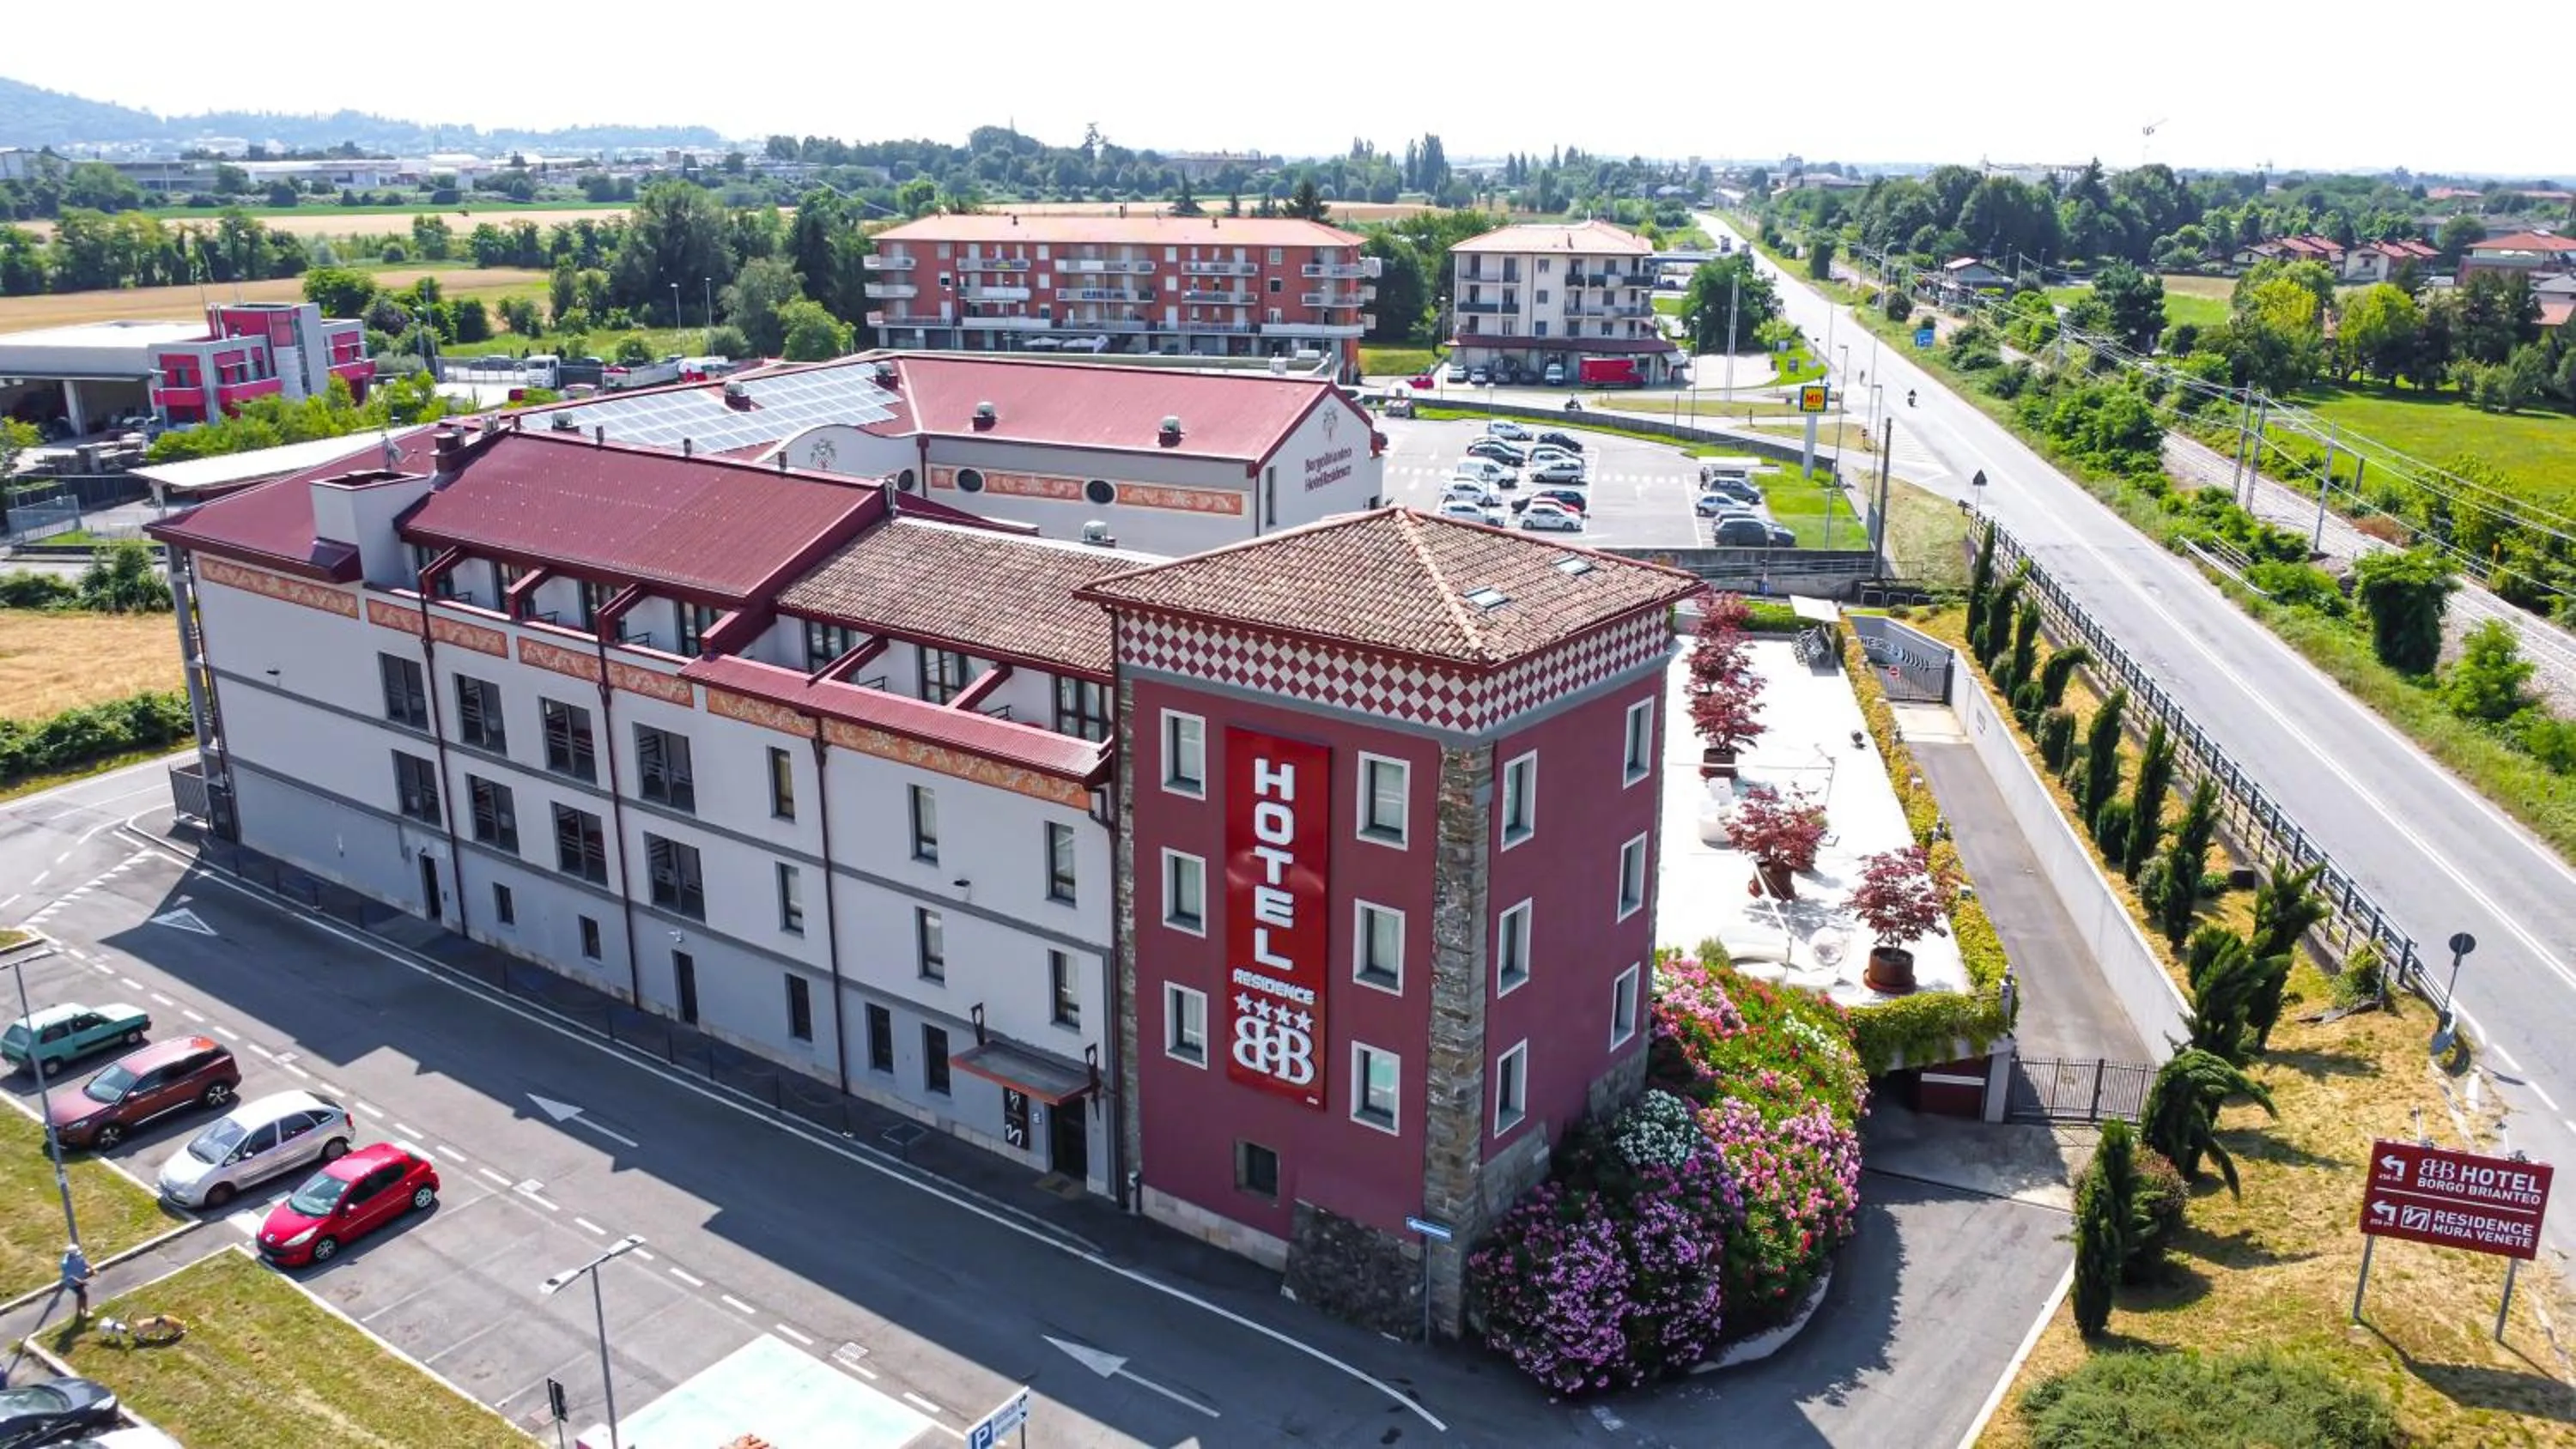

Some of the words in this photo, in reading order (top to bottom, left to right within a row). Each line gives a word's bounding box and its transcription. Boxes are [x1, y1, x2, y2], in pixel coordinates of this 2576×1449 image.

[1255, 758, 1295, 971] HOTEL
[1233, 968, 1315, 1005] RESIDENCE
[2417, 1177, 2465, 1194] BORGO
[2468, 1187, 2541, 1205] BRIANTEO
[2461, 1165, 2543, 1193] HOTEL
[2432, 1225, 2472, 1240] MURA
[2476, 1231, 2532, 1248] VENETE
[2434, 1210, 2535, 1237] RESIDENCE
[975, 1424, 990, 1449] P
